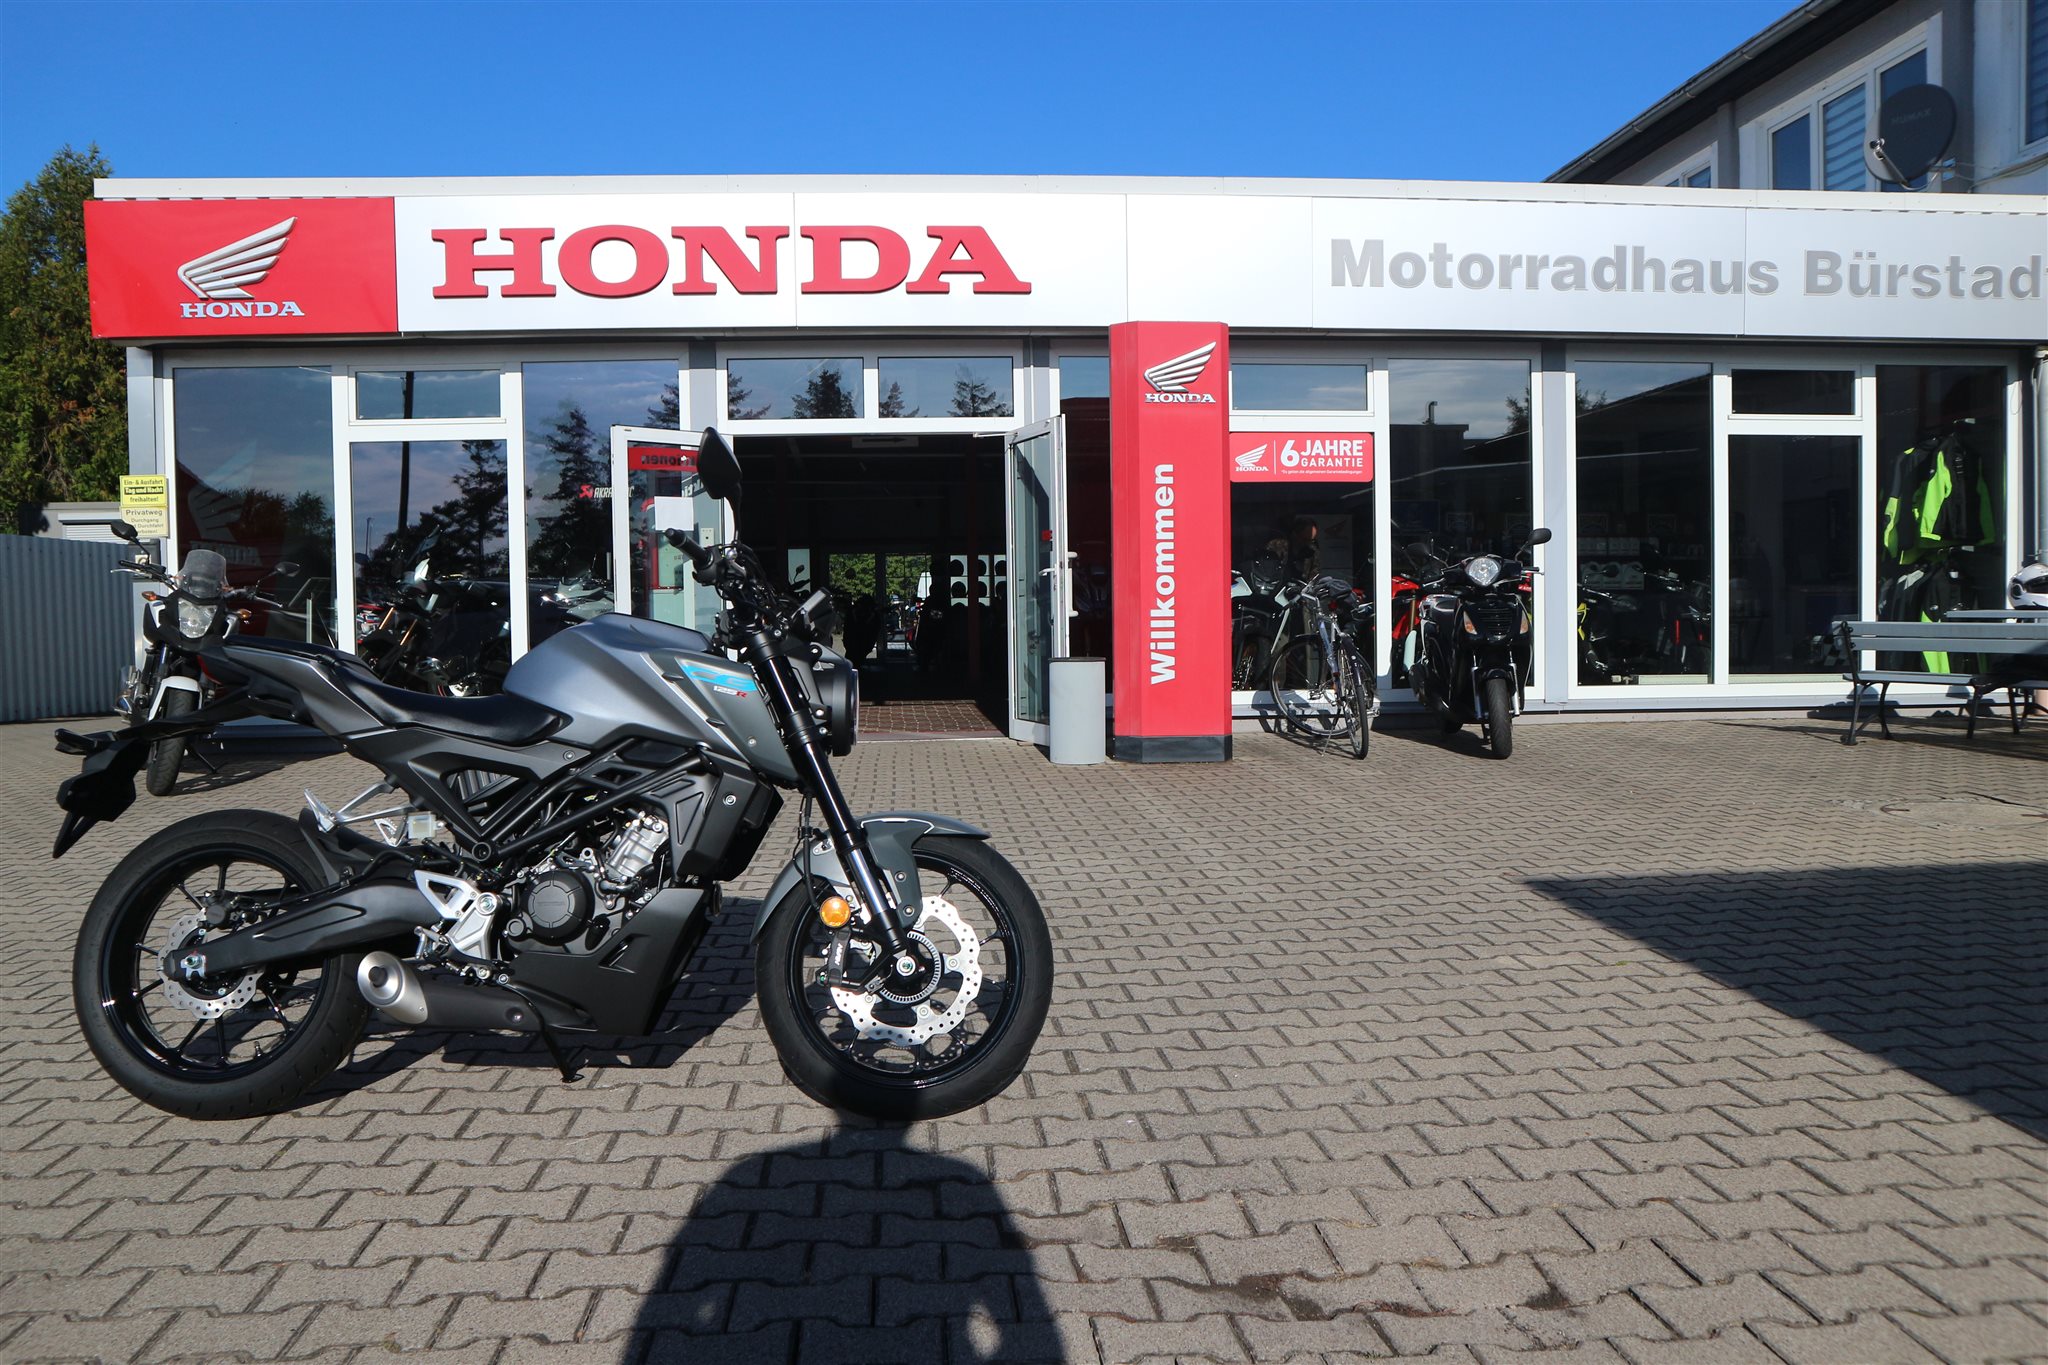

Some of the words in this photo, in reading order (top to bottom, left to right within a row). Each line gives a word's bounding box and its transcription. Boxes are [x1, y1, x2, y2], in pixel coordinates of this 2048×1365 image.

[432, 225, 1032, 298] HONDA
[1331, 238, 1779, 296] Motorradhaus
[1804, 250, 2048, 300] Bürstad
[180, 301, 305, 318] HONDA
[1145, 392, 1217, 403] HONDA
[1280, 439, 1300, 468] 6
[1301, 457, 1364, 468] GARANTIE
[1150, 464, 1176, 685] Willkommen
